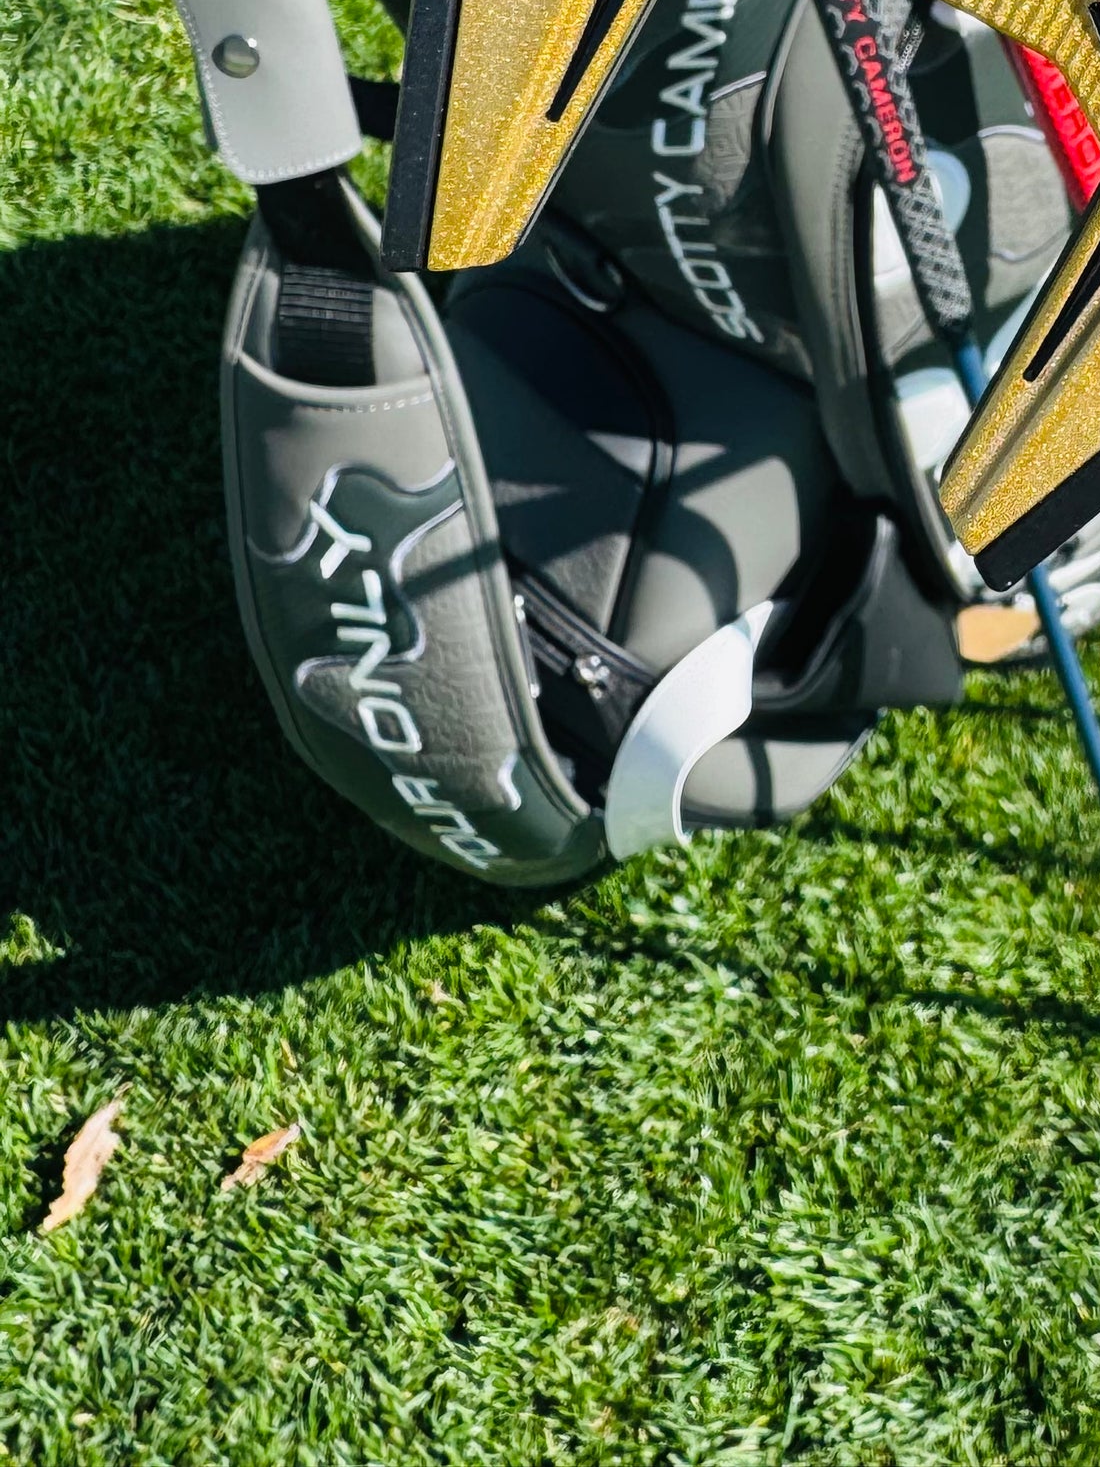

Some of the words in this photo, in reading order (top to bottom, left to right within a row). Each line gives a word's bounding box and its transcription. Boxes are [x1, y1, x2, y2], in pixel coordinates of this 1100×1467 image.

[853, 35, 917, 183] CAMERON
[652, 171, 765, 344] SCOTTY
[309, 499, 423, 755] ONLY
